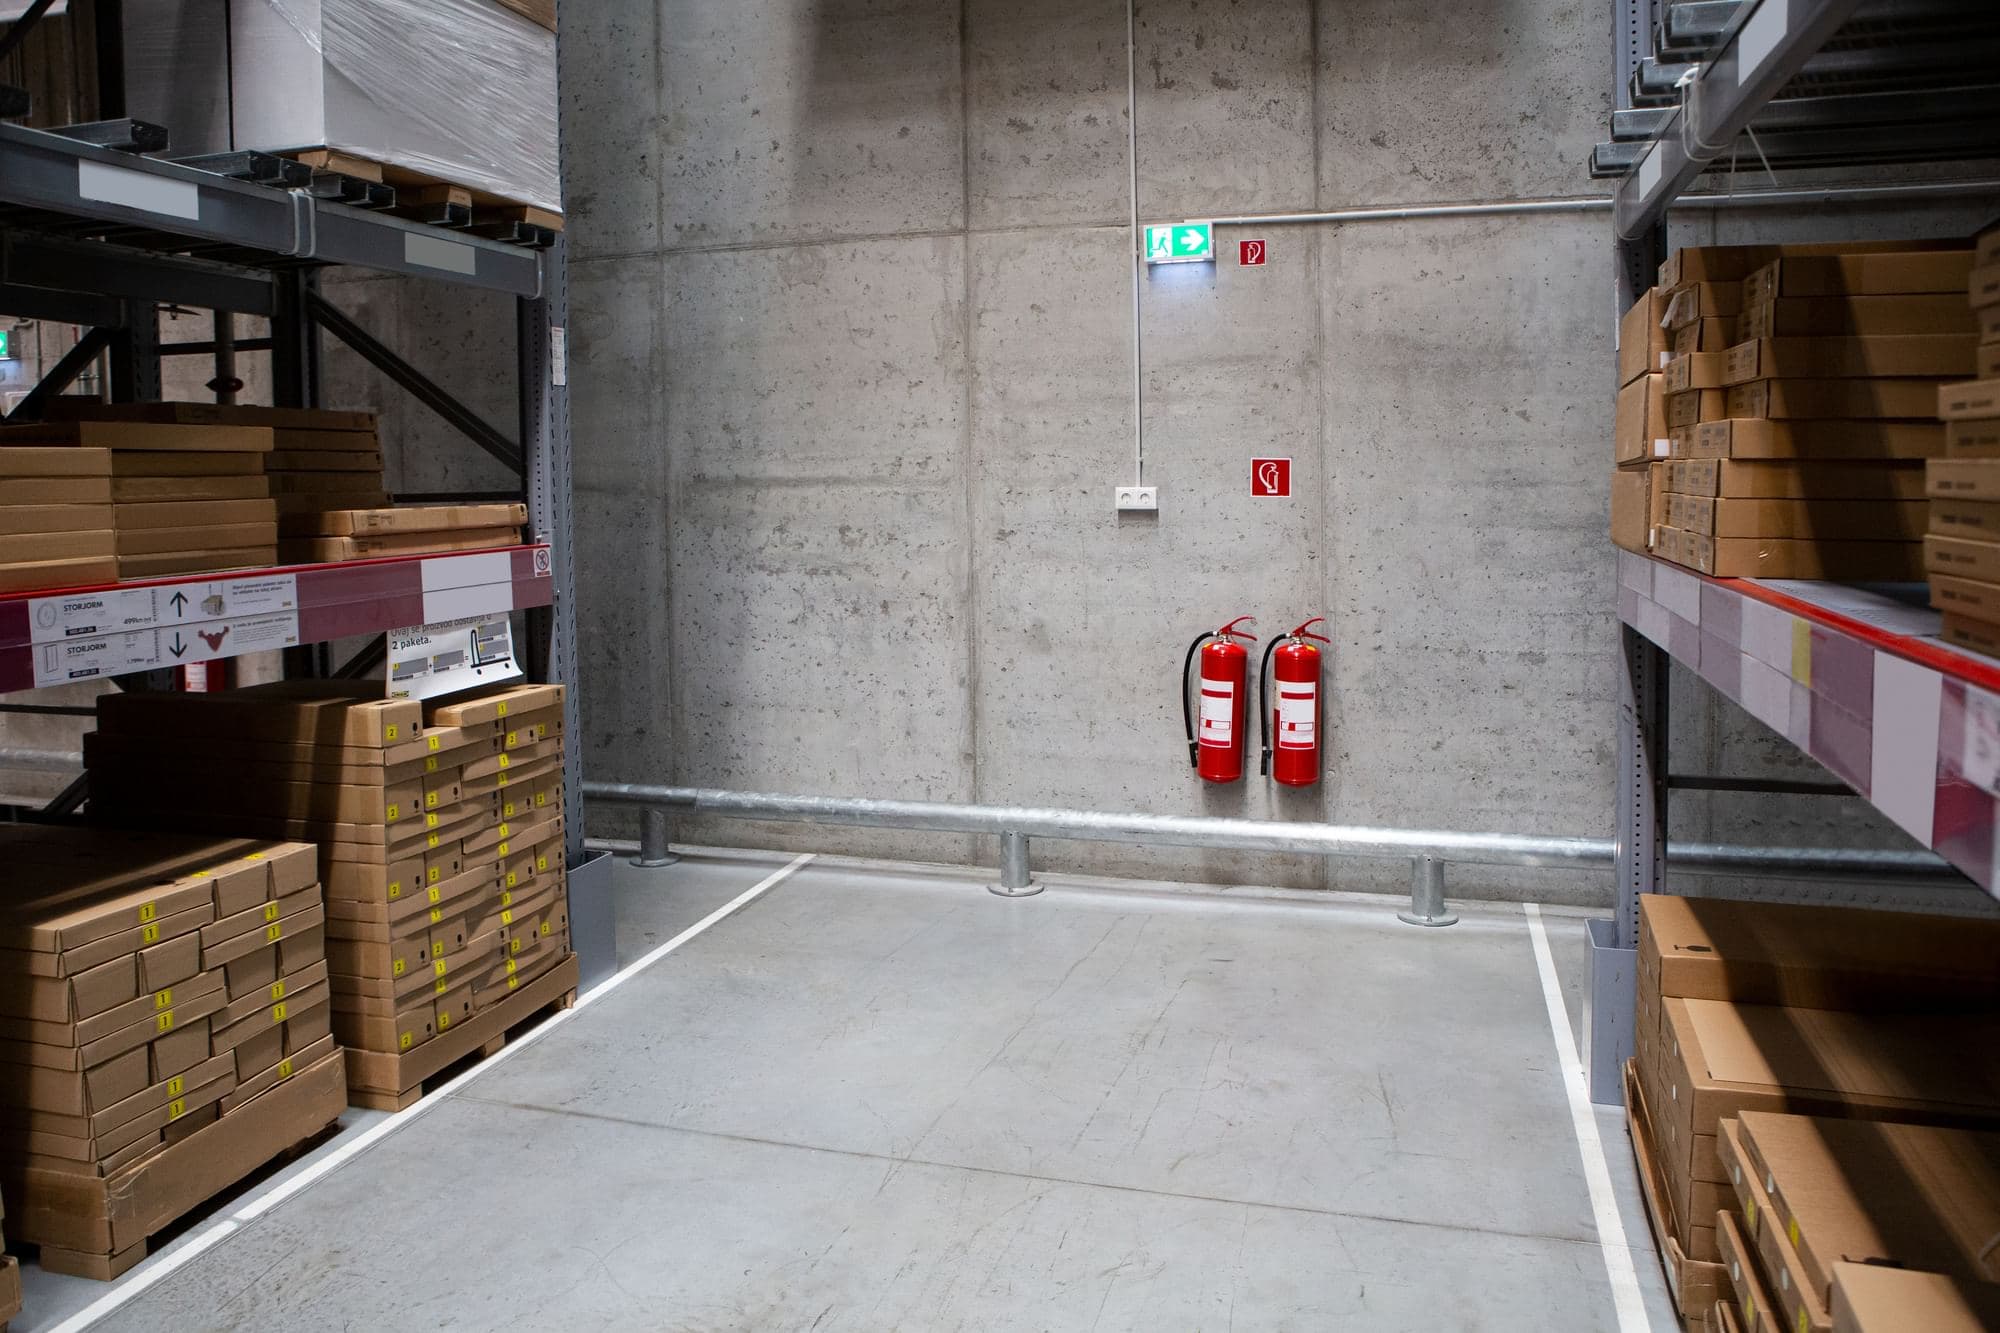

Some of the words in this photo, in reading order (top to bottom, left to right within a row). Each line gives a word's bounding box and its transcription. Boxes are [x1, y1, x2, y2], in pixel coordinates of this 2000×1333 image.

[64, 601, 103, 612] STORJORM
[67, 643, 107, 654] STORJORM
[392, 641, 398, 650] 2
[400, 636, 432, 651] paketa.
